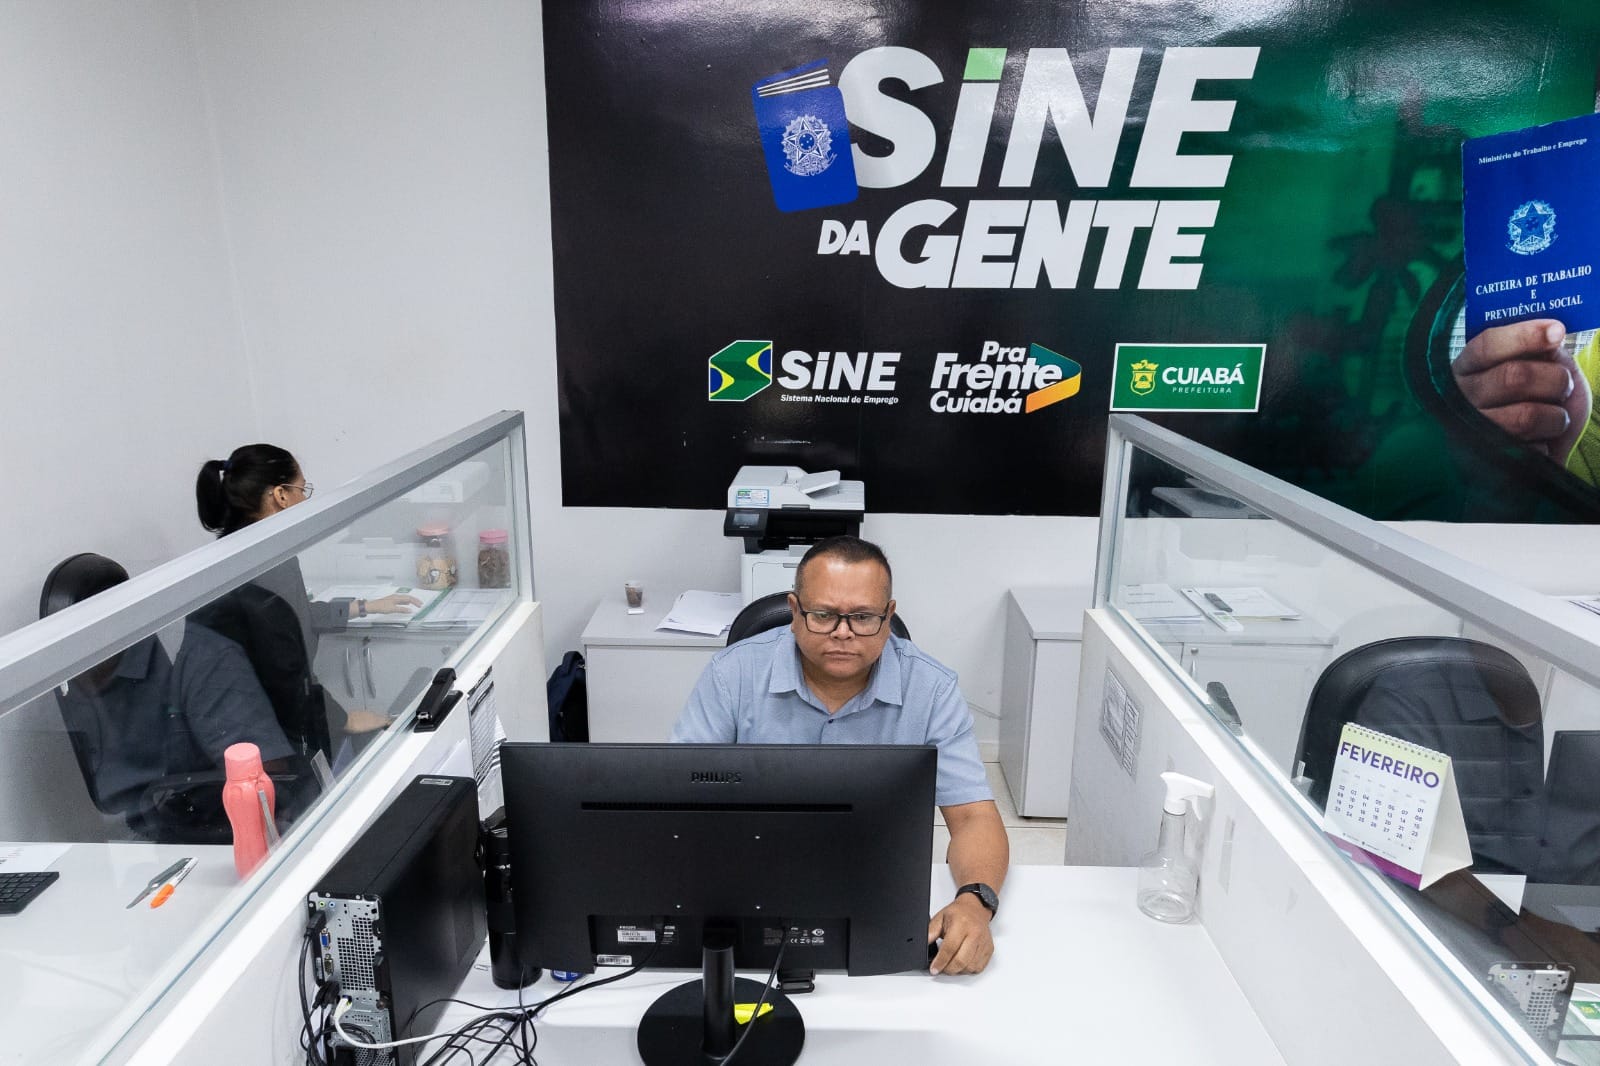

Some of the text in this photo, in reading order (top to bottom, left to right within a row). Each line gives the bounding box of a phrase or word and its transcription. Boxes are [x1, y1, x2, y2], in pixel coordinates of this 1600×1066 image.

[1478, 151, 1512, 165] Ministério
[1522, 144, 1552, 156] Trabalho
[1557, 137, 1588, 149] Emprego
[816, 198, 1221, 290] DA GENTE
[1475, 264, 1592, 296] CARTEIRA DE TRABALHO
[1530, 289, 1537, 300] E
[1484, 294, 1583, 322] PREVIDÊNCIA SOCIAL
[980, 341, 1026, 362] Pra
[930, 352, 1063, 391] Frente
[1161, 363, 1245, 385] CUIABÁ
[780, 394, 899, 405] Sistema Nacional de Emprego
[929, 390, 1023, 414] Cuiabá
[1172, 386, 1232, 394] PREFEITURA
[1340, 741, 1440, 788] FEVEREIRO
[691, 771, 742, 784] PHILIPS
